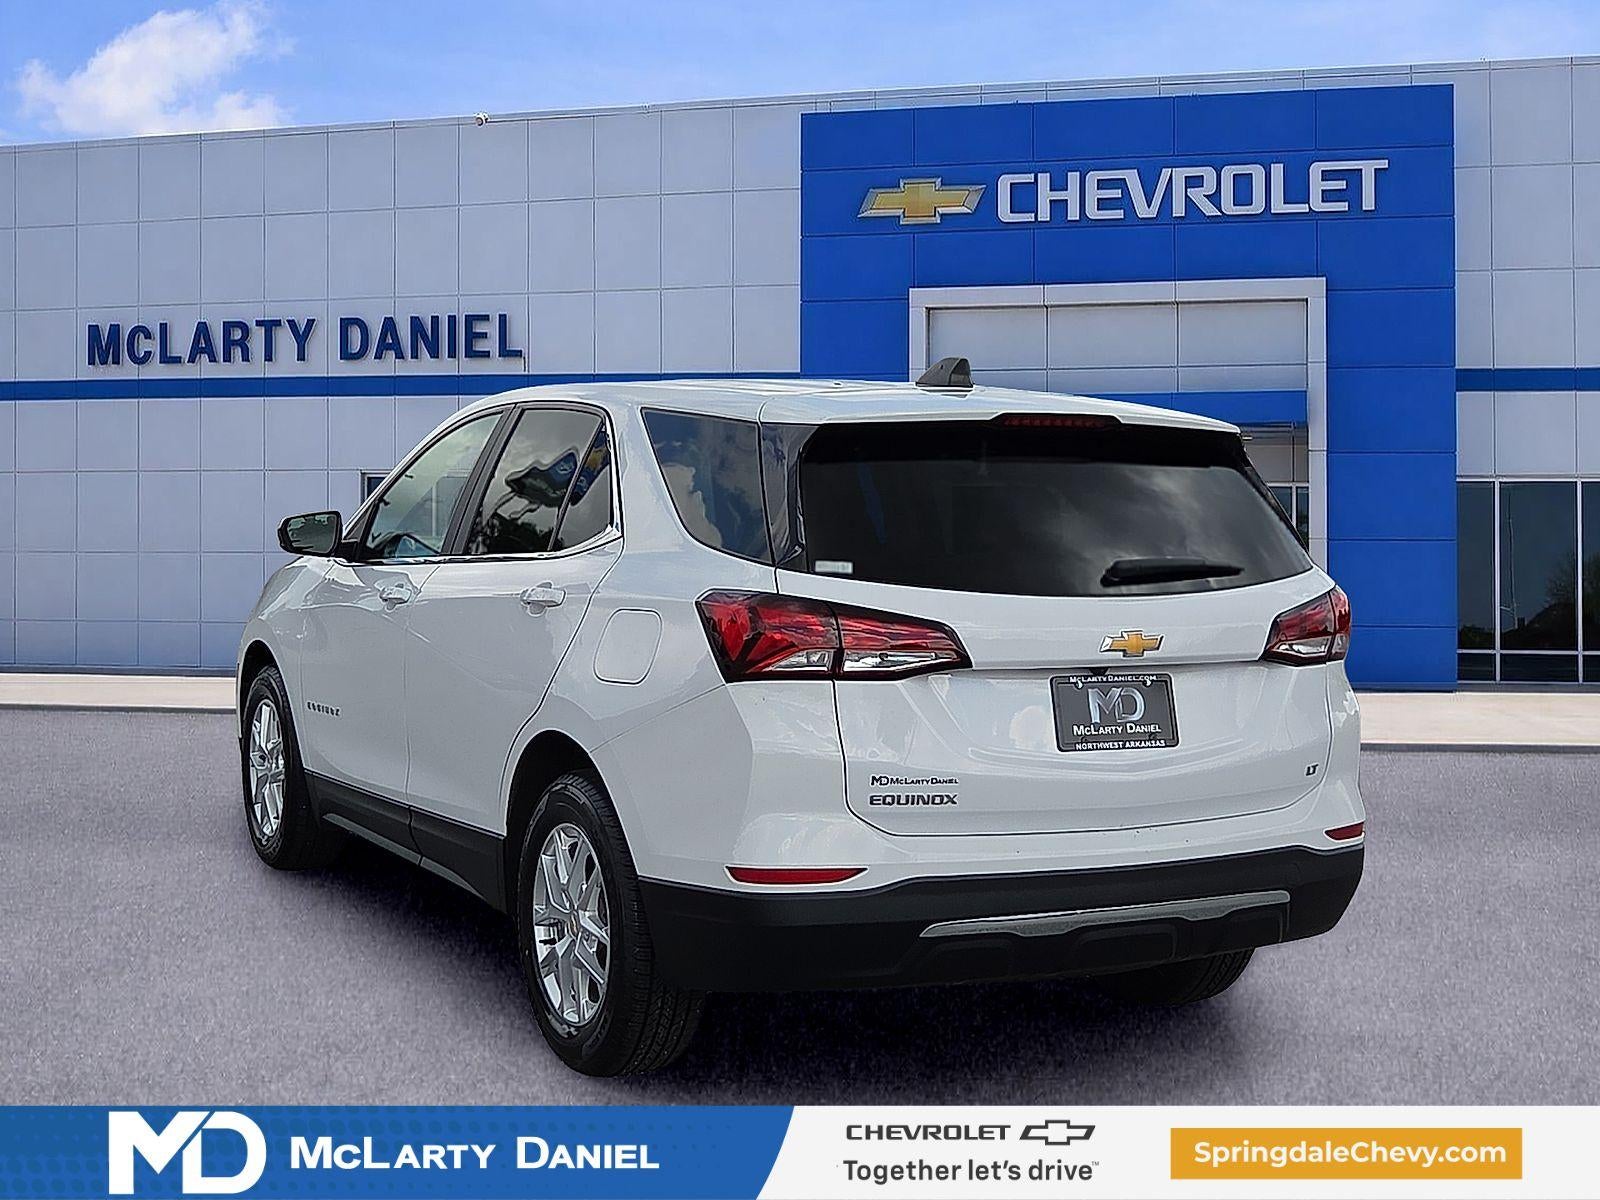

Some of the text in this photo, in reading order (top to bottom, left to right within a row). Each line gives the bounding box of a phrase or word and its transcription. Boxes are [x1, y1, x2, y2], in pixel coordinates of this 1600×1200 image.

[997, 158, 1389, 224] CHEVROLET
[338, 313, 523, 361] DANIEL
[1088, 687, 1145, 723] MD
[1127, 722, 1162, 733] DANIEL
[1076, 739, 1166, 750] NORTHWEST ARKANSAS
[1305, 763, 1319, 776] LT
[869, 794, 957, 806] EQUINOX
